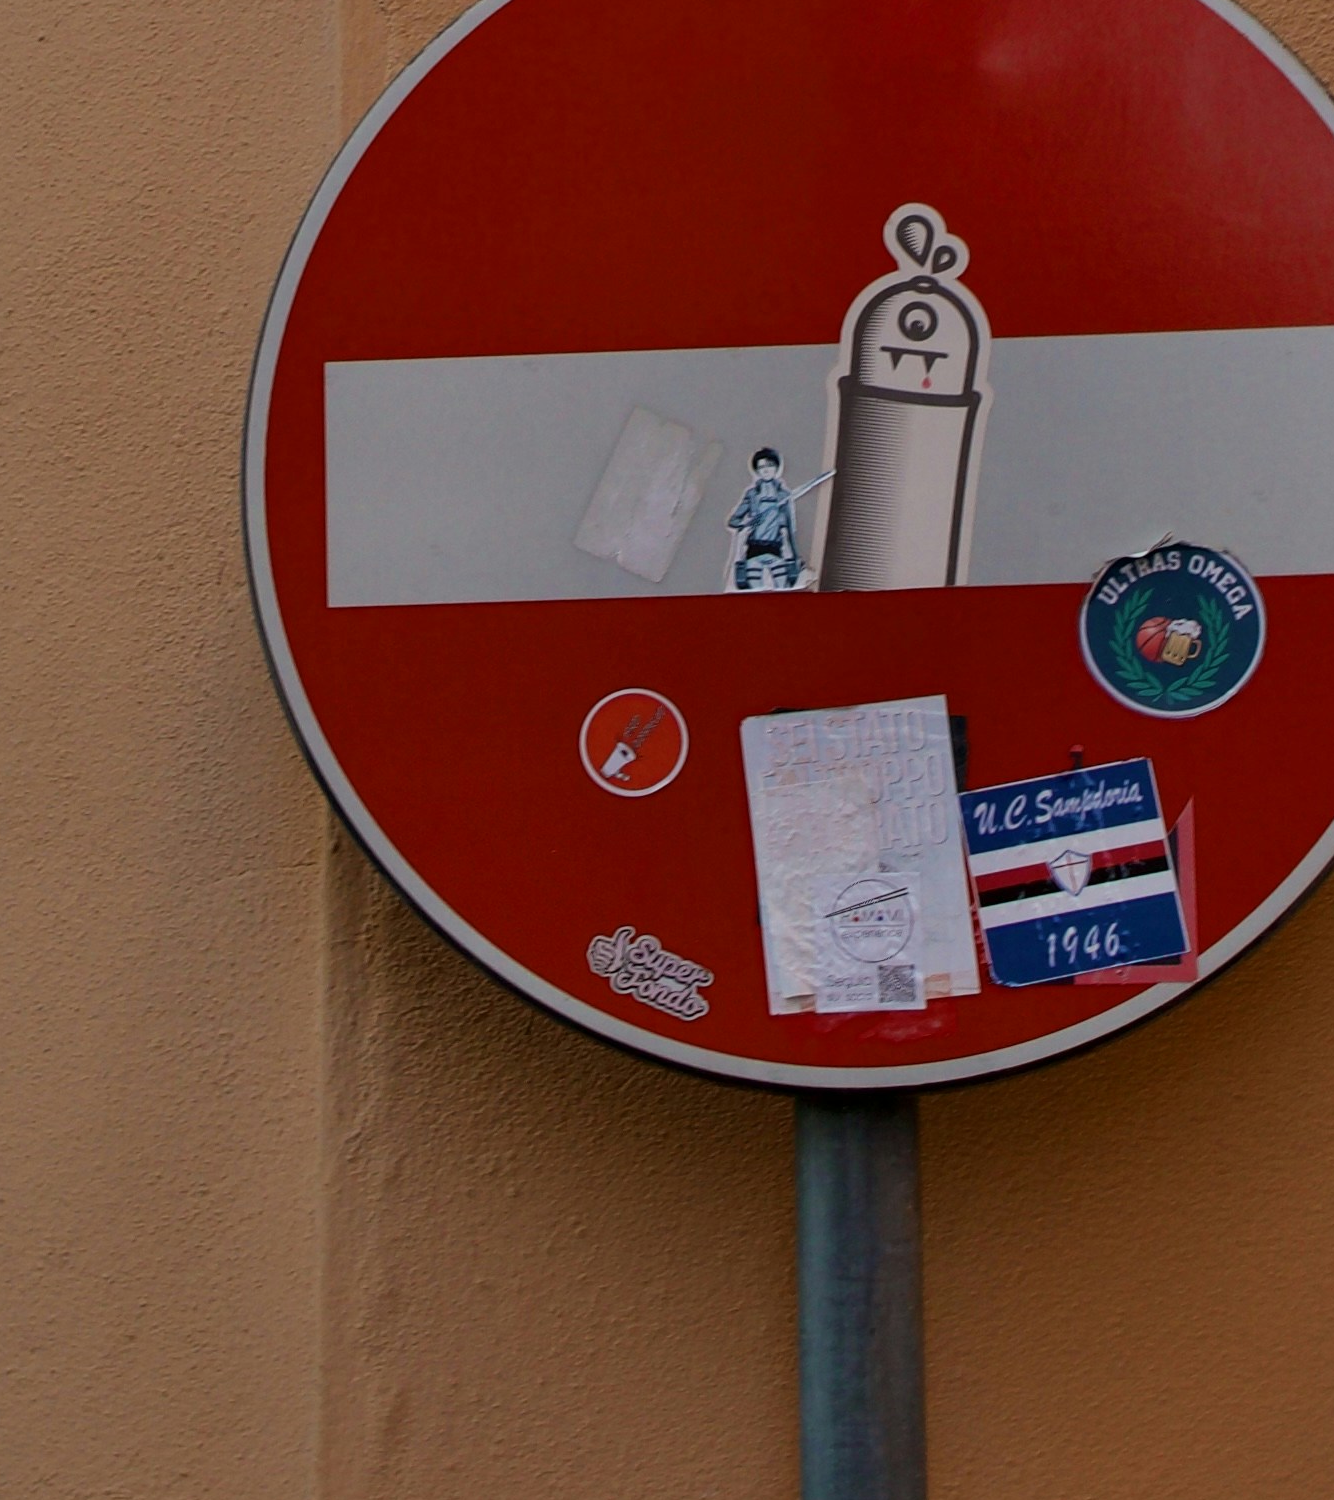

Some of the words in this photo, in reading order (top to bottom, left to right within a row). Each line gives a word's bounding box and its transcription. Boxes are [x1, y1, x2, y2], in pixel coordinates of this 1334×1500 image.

[1097, 551, 1182, 605] ULTRAS
[1187, 555, 1255, 621] OMEGA
[628, 938, 710, 983] Super
[1046, 922, 1121, 968] 1946
